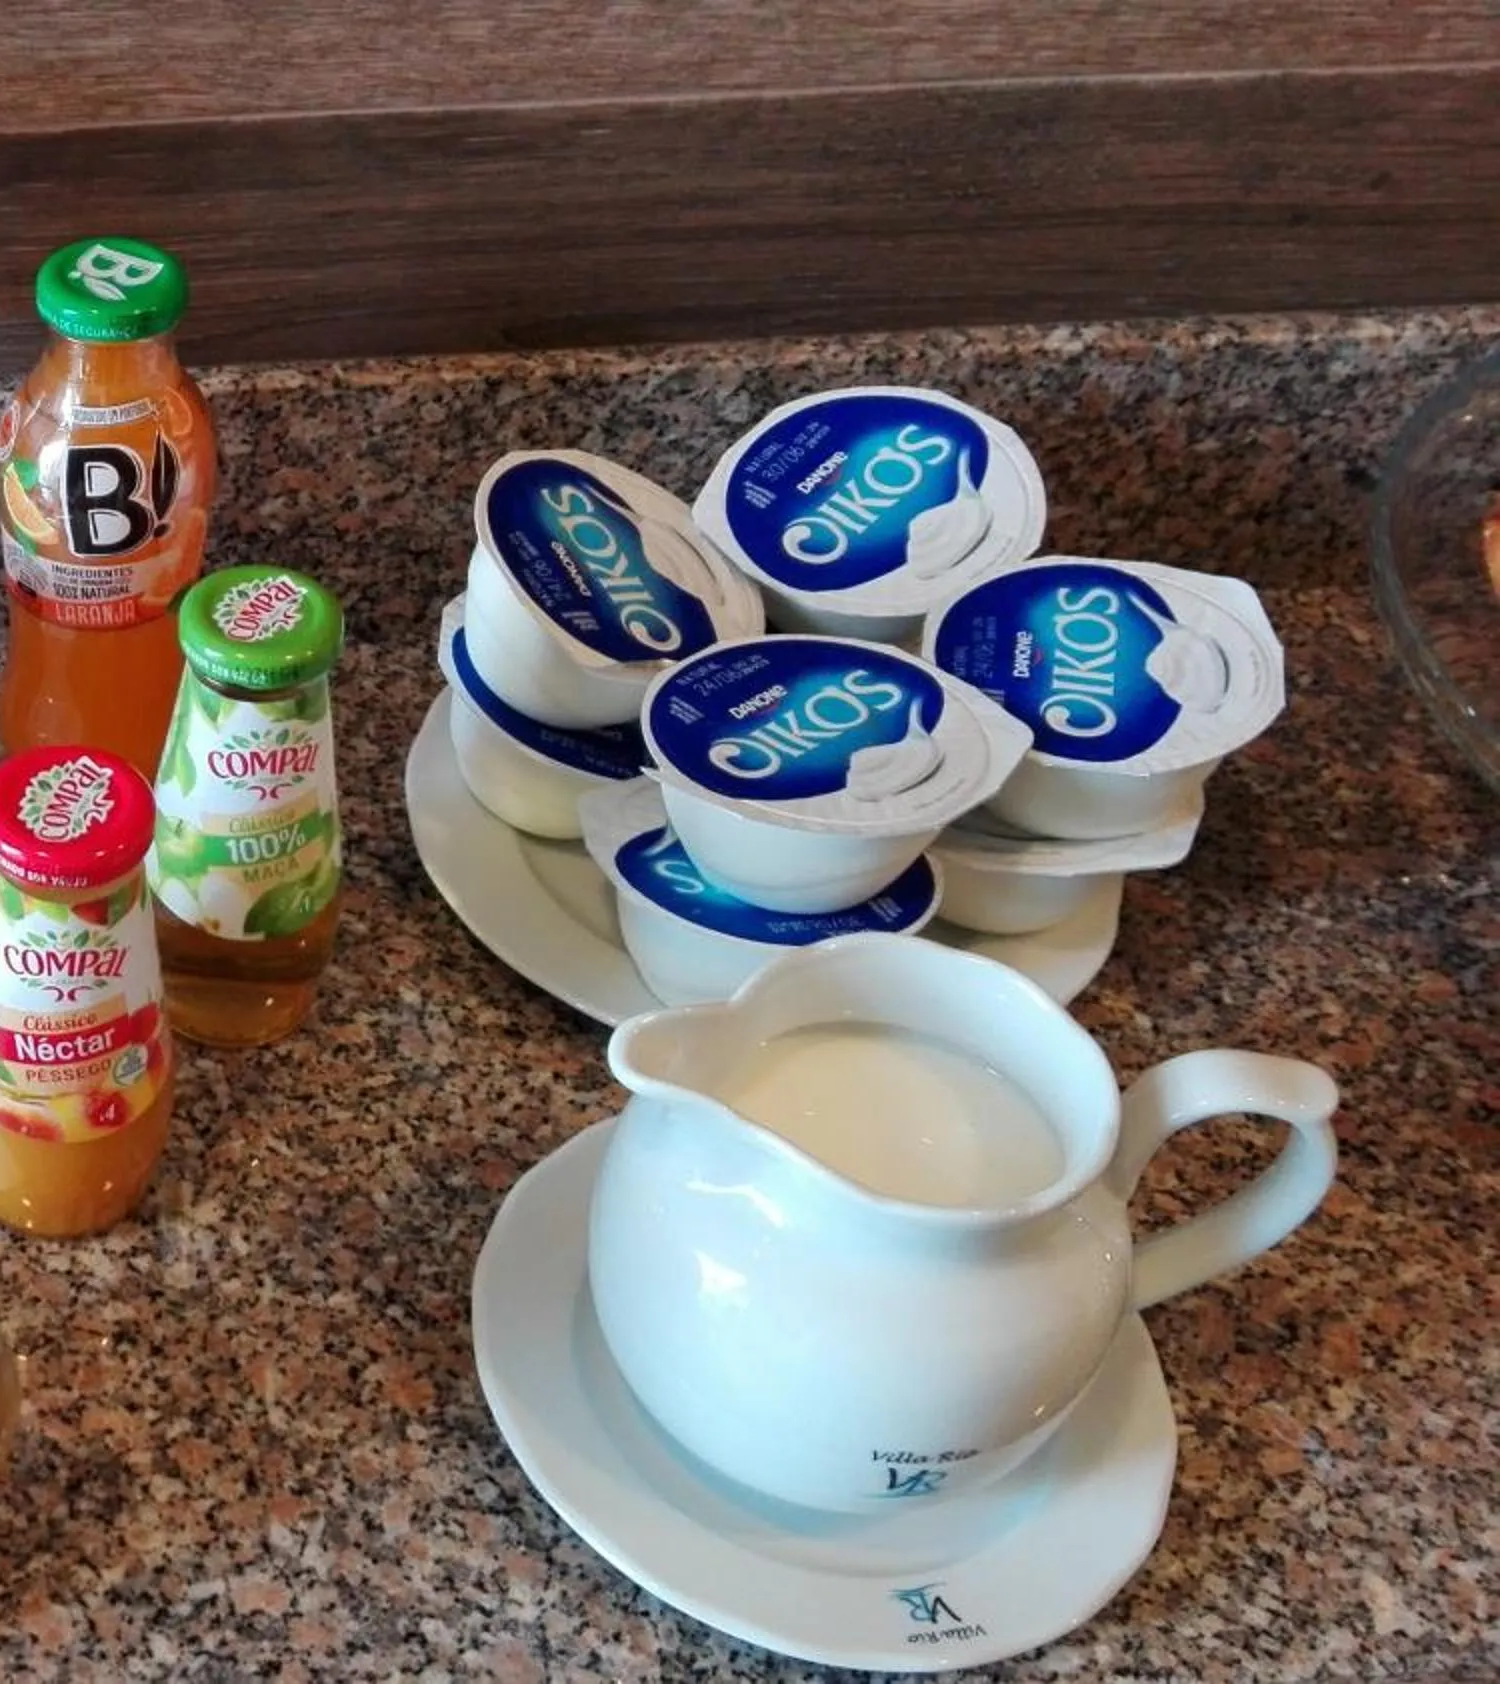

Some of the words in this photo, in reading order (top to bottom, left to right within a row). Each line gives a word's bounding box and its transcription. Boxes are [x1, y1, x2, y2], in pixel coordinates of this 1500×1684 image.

[796, 451, 848, 494] DANONE
[781, 425, 951, 564] OIKOS
[52, 564, 134, 580] INGREDIENTES
[541, 485, 683, 652] OIKOS
[81, 584, 131, 599] NATURAL
[55, 600, 136, 626] LARANJA
[1013, 631, 1034, 678] DANONE
[1041, 588, 1120, 737] OIKOS
[728, 685, 788, 719] DANONE
[708, 670, 904, 779] OIKOS
[225, 823, 305, 864] 100%
[13, 1028, 115, 1061] Néctar
